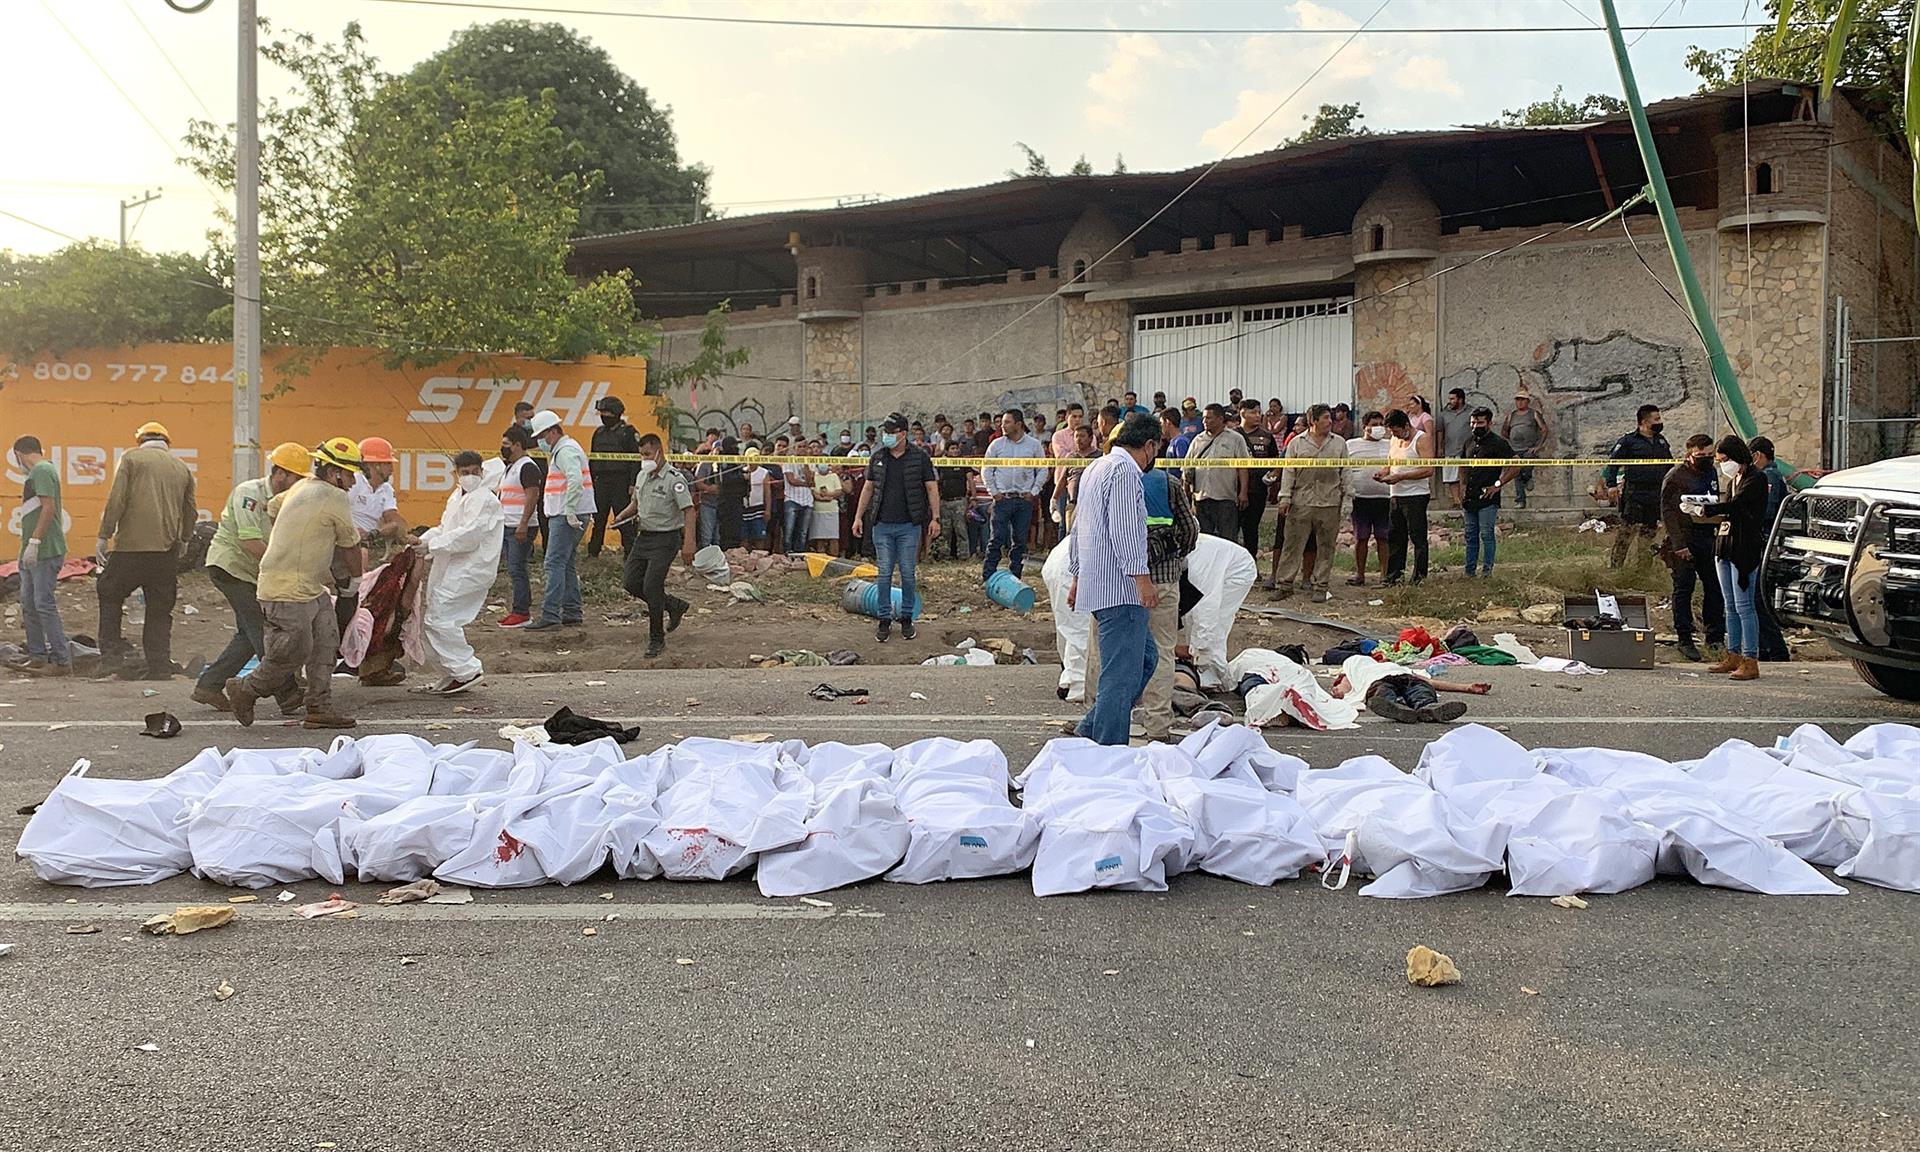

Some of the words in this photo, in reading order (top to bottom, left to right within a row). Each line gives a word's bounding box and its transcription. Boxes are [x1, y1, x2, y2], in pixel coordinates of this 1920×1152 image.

[33, 362, 92, 381] 800
[106, 363, 168, 382] 777
[406, 376, 629, 427] STIHL
